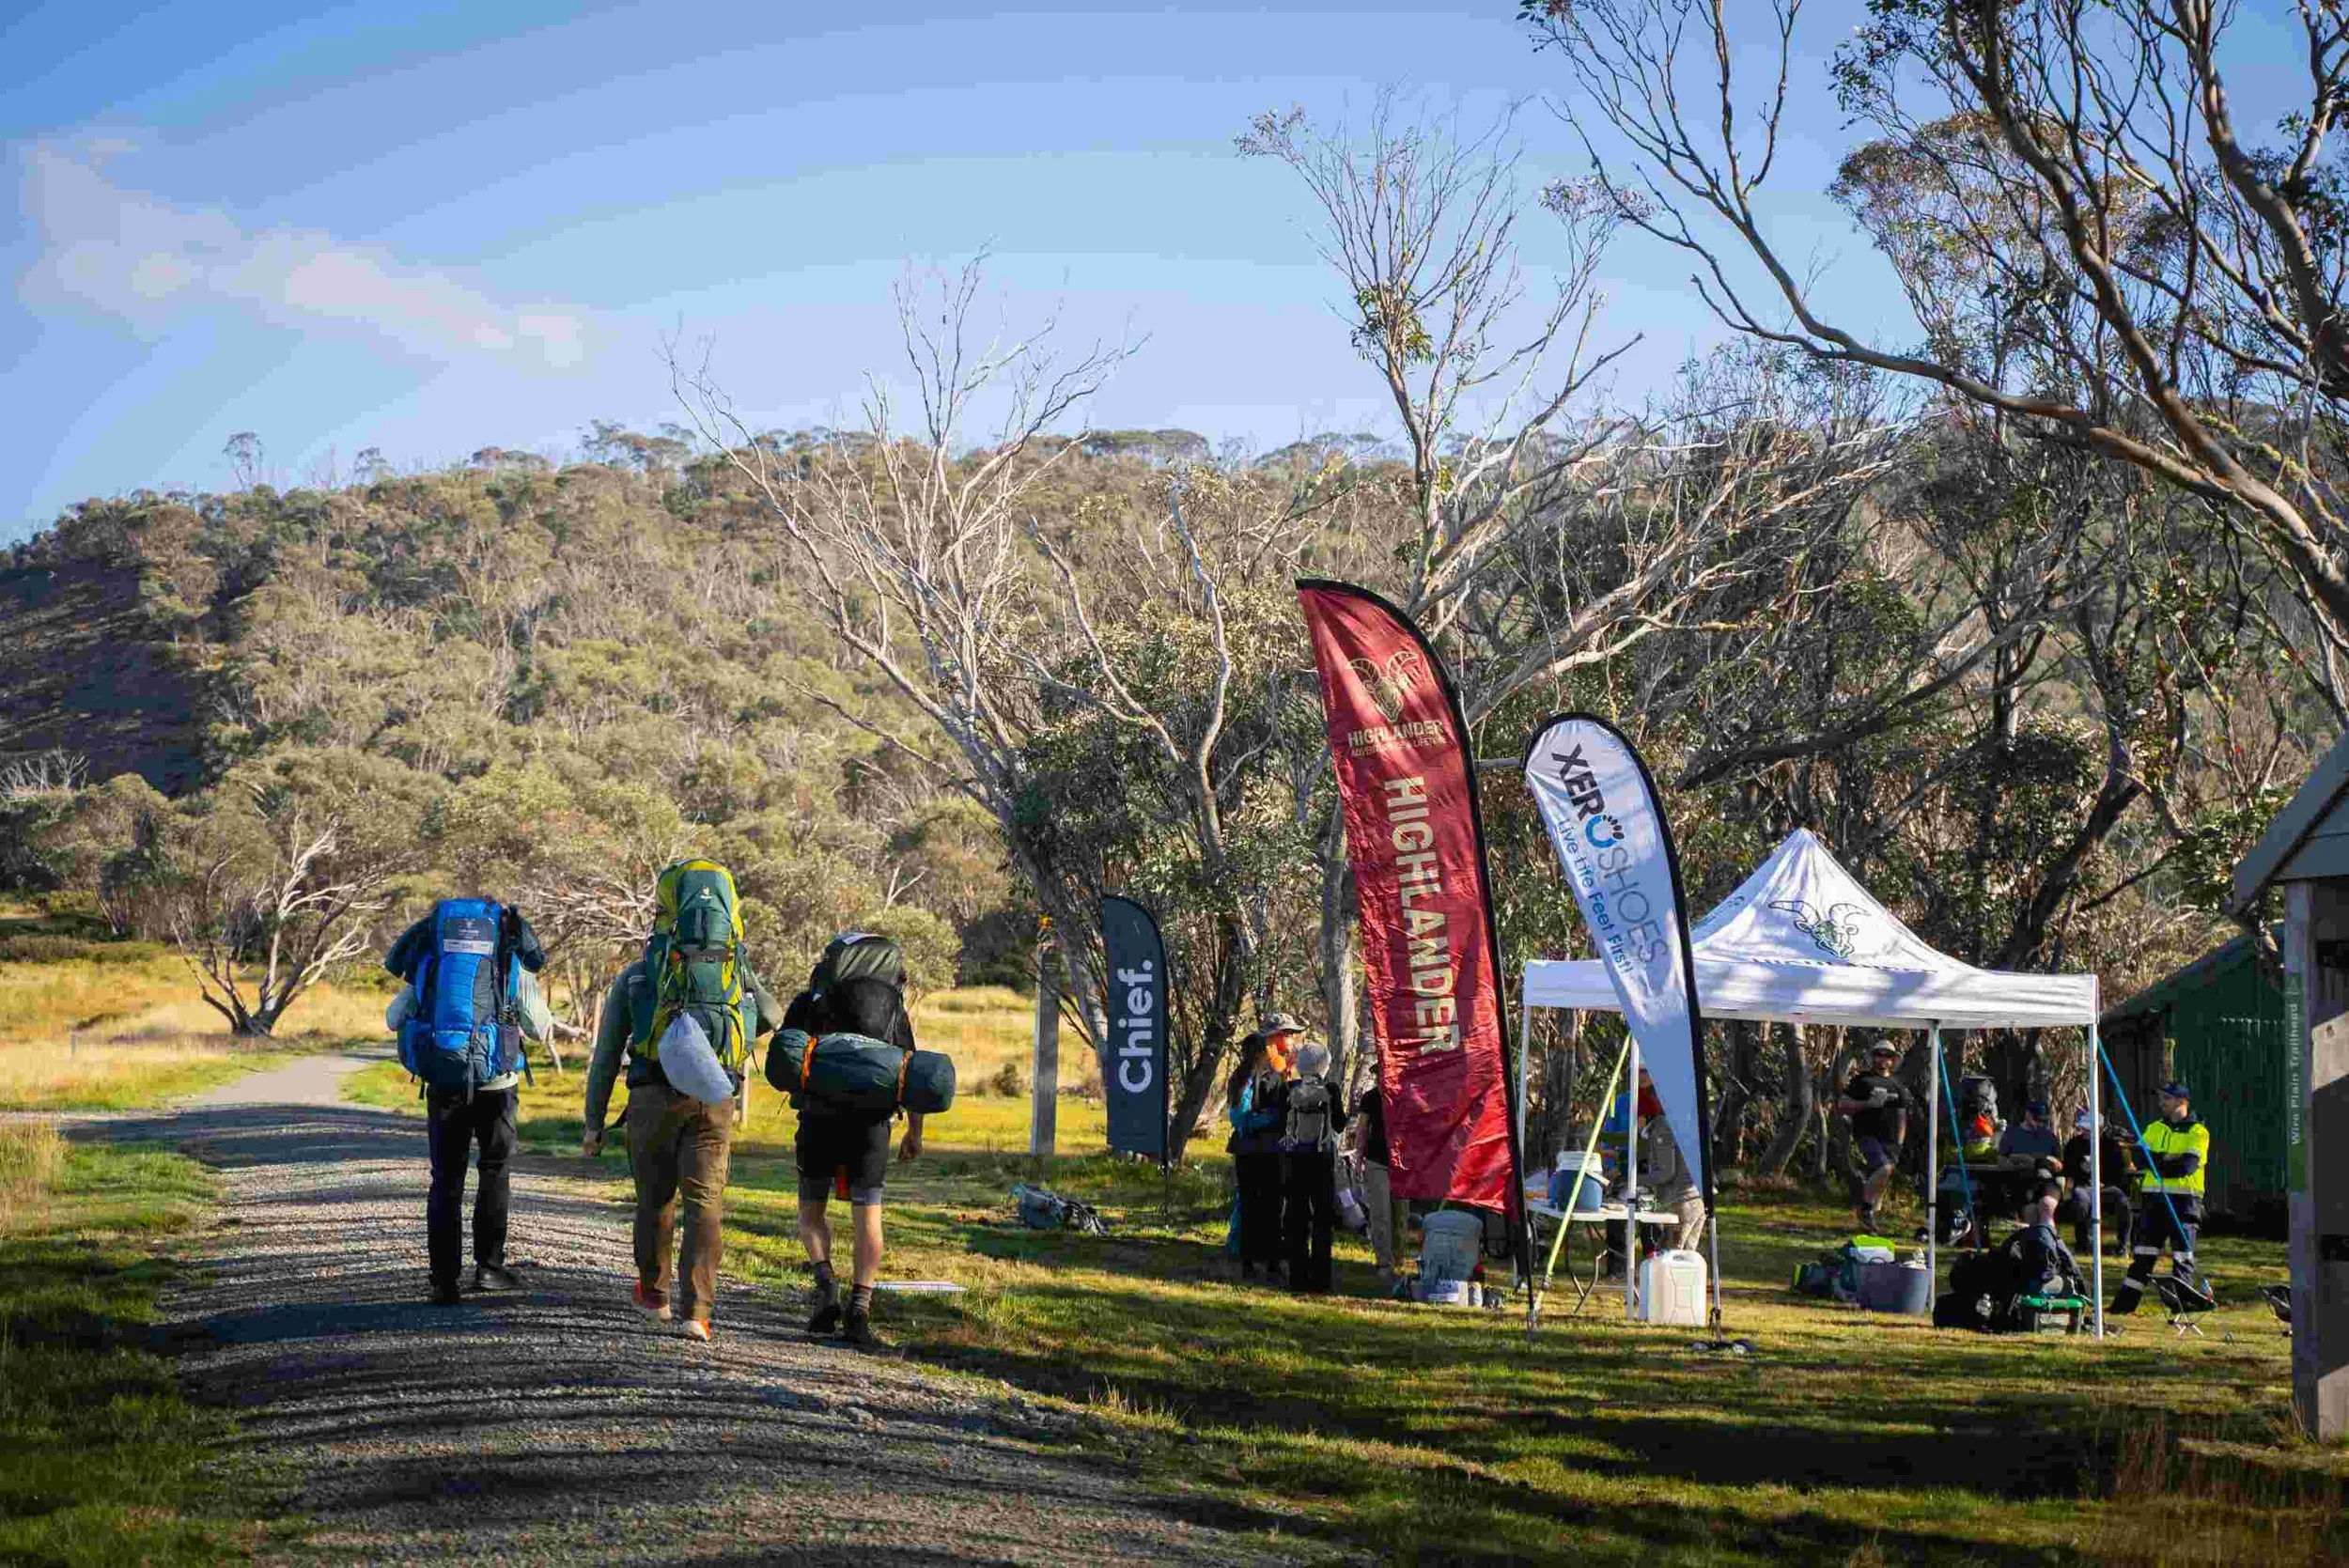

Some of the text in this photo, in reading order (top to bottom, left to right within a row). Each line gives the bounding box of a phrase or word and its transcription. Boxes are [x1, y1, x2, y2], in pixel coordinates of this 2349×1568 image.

[1347, 720, 1444, 748] HIGHLANDER
[1551, 741, 1667, 964] XERO SHOES
[1557, 819, 1579, 855] Live
[1574, 855, 1595, 888] Life
[1588, 891, 1615, 931] Feet
[1384, 776, 1460, 1055] HIGHLANDER
[1117, 959, 1153, 1093] Chief.
[2288, 1003, 2299, 1071] Trailhead
